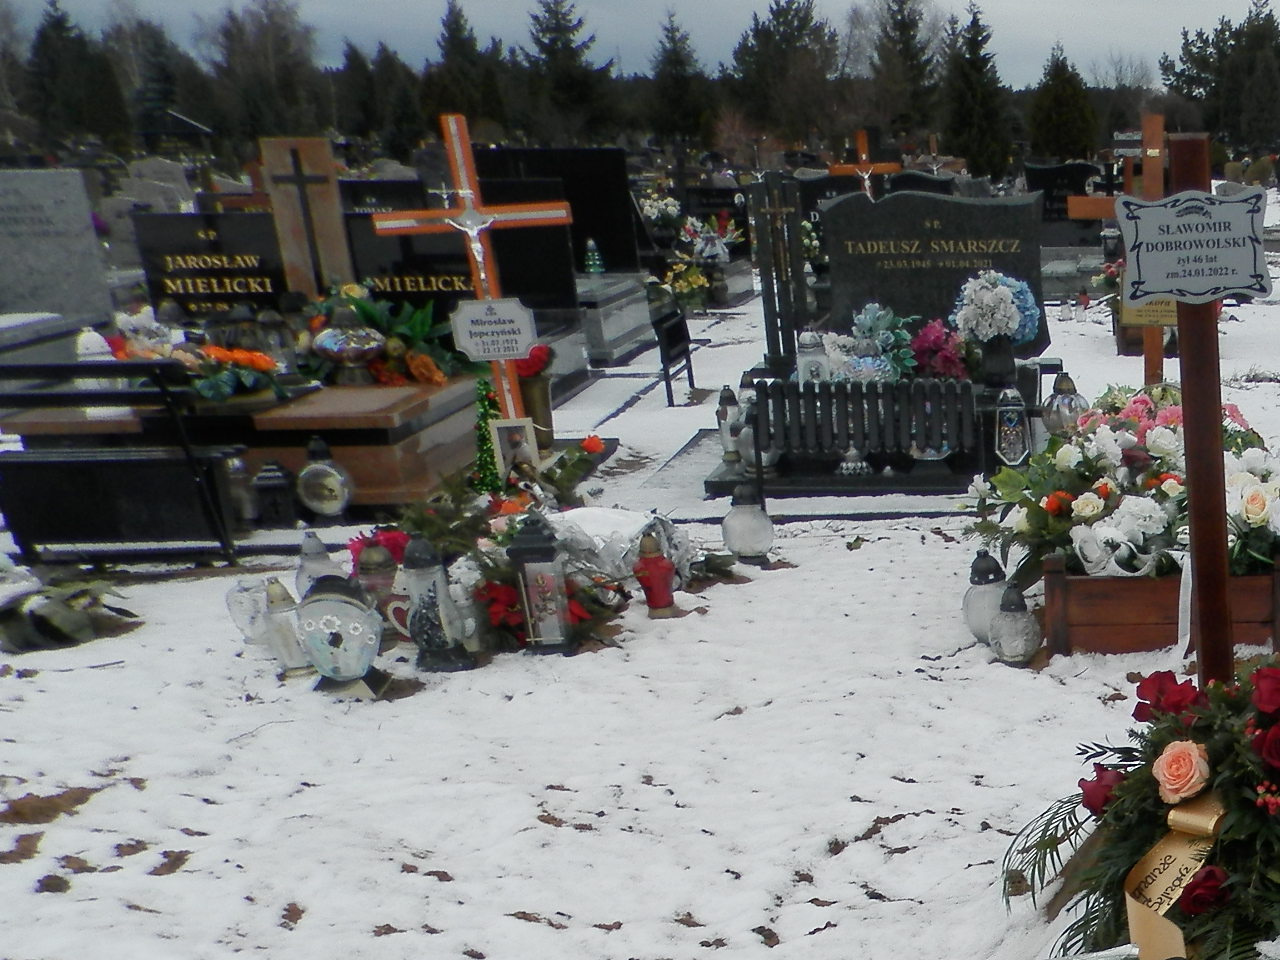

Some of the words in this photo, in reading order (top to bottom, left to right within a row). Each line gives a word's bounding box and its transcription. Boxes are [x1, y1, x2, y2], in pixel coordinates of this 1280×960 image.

[845, 240, 920, 254] TADEUSZ
[931, 239, 1021, 254] SMARSZCZ
[1145, 237, 1246, 252] DOBROWOLSKI
[1192, 255, 1204, 264] 46
[163, 278, 273, 294] MIELICKI
[374, 277, 474, 291] MIELICK
